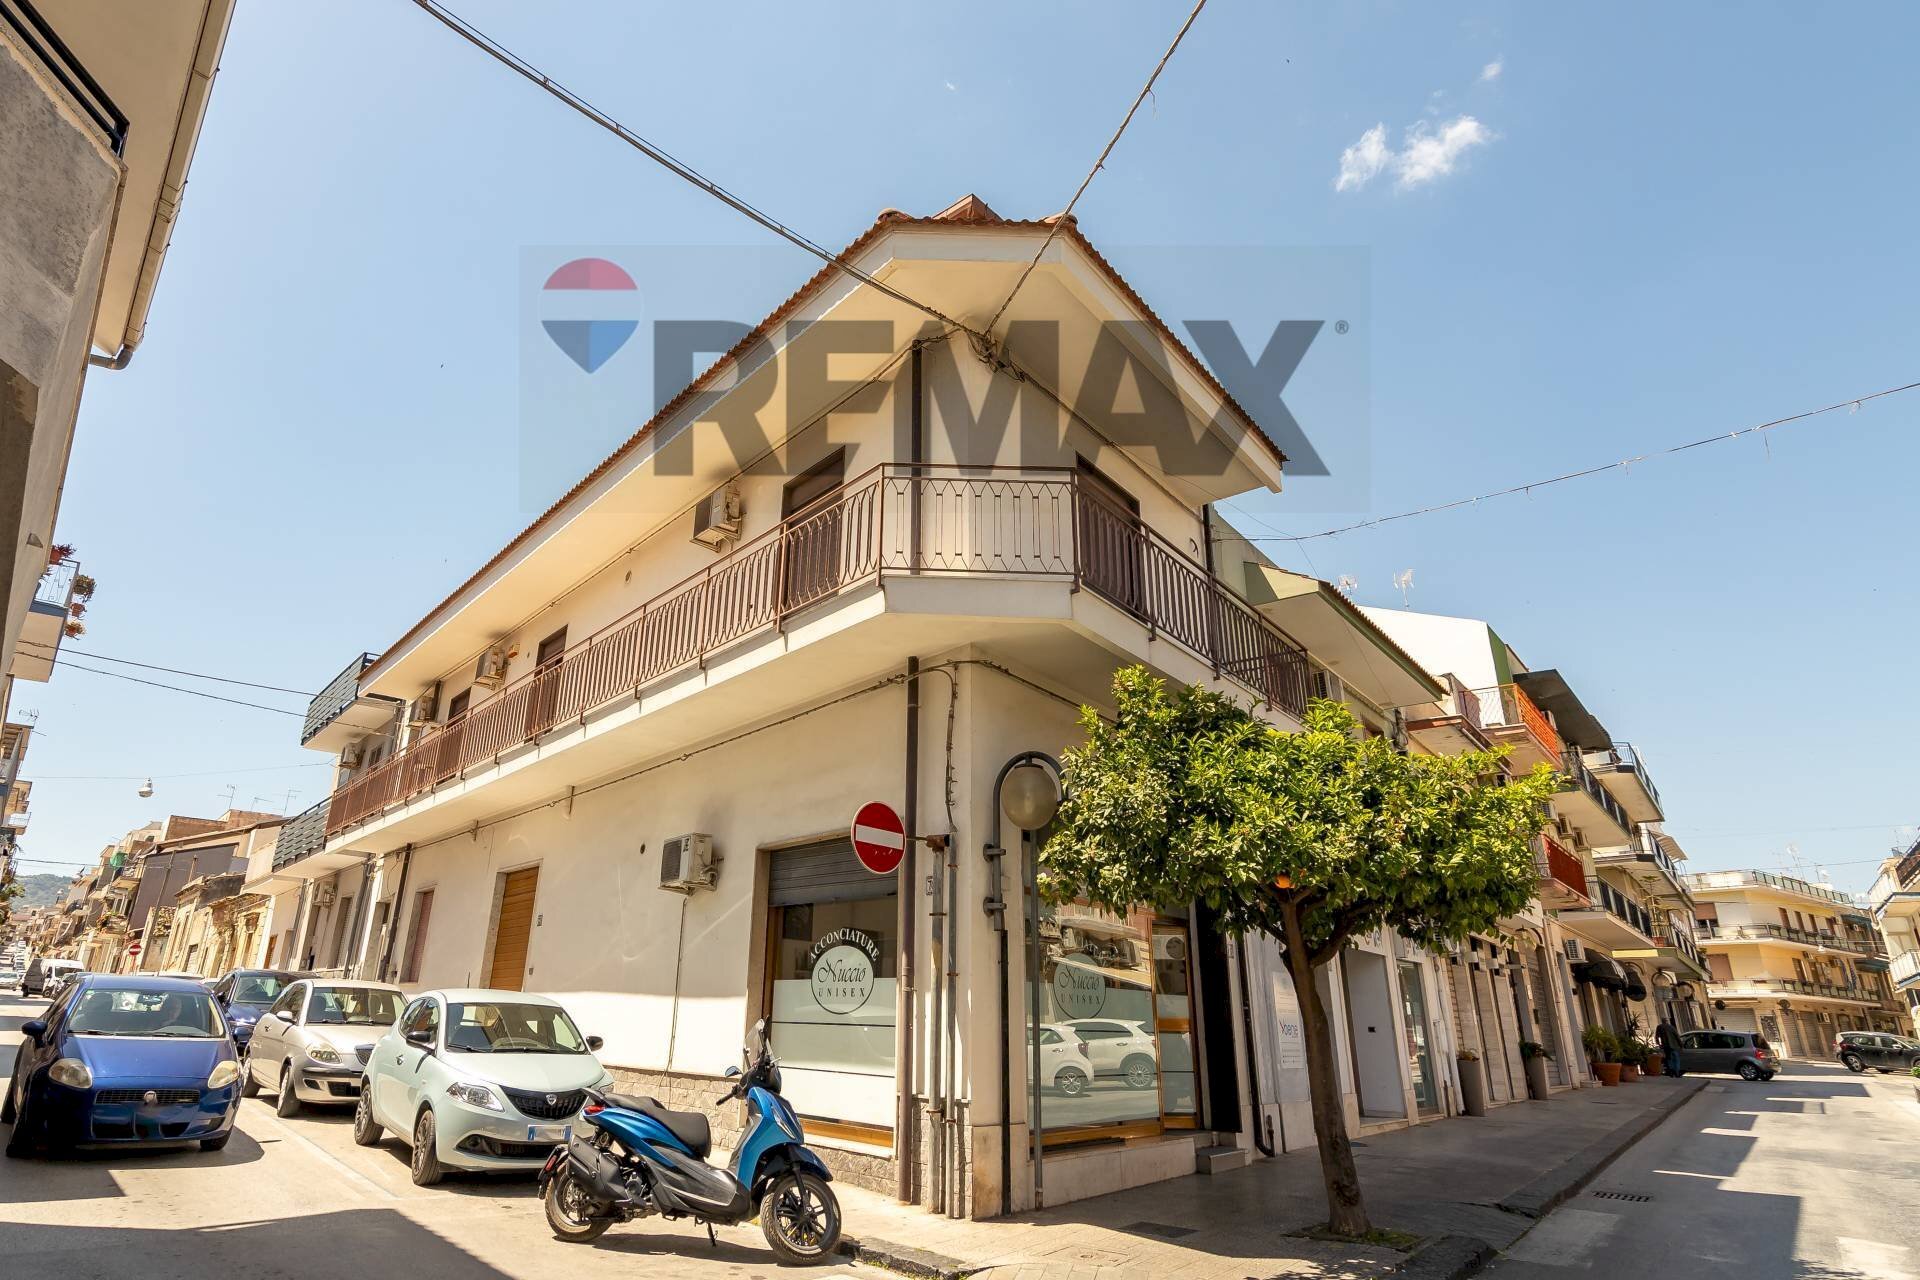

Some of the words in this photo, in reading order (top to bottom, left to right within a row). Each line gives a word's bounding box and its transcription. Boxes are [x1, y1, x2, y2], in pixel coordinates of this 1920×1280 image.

[809, 927, 880, 963] ACCONCIATURE
[817, 958, 867, 984] Nuccio
[818, 987, 866, 998] UNISEX
